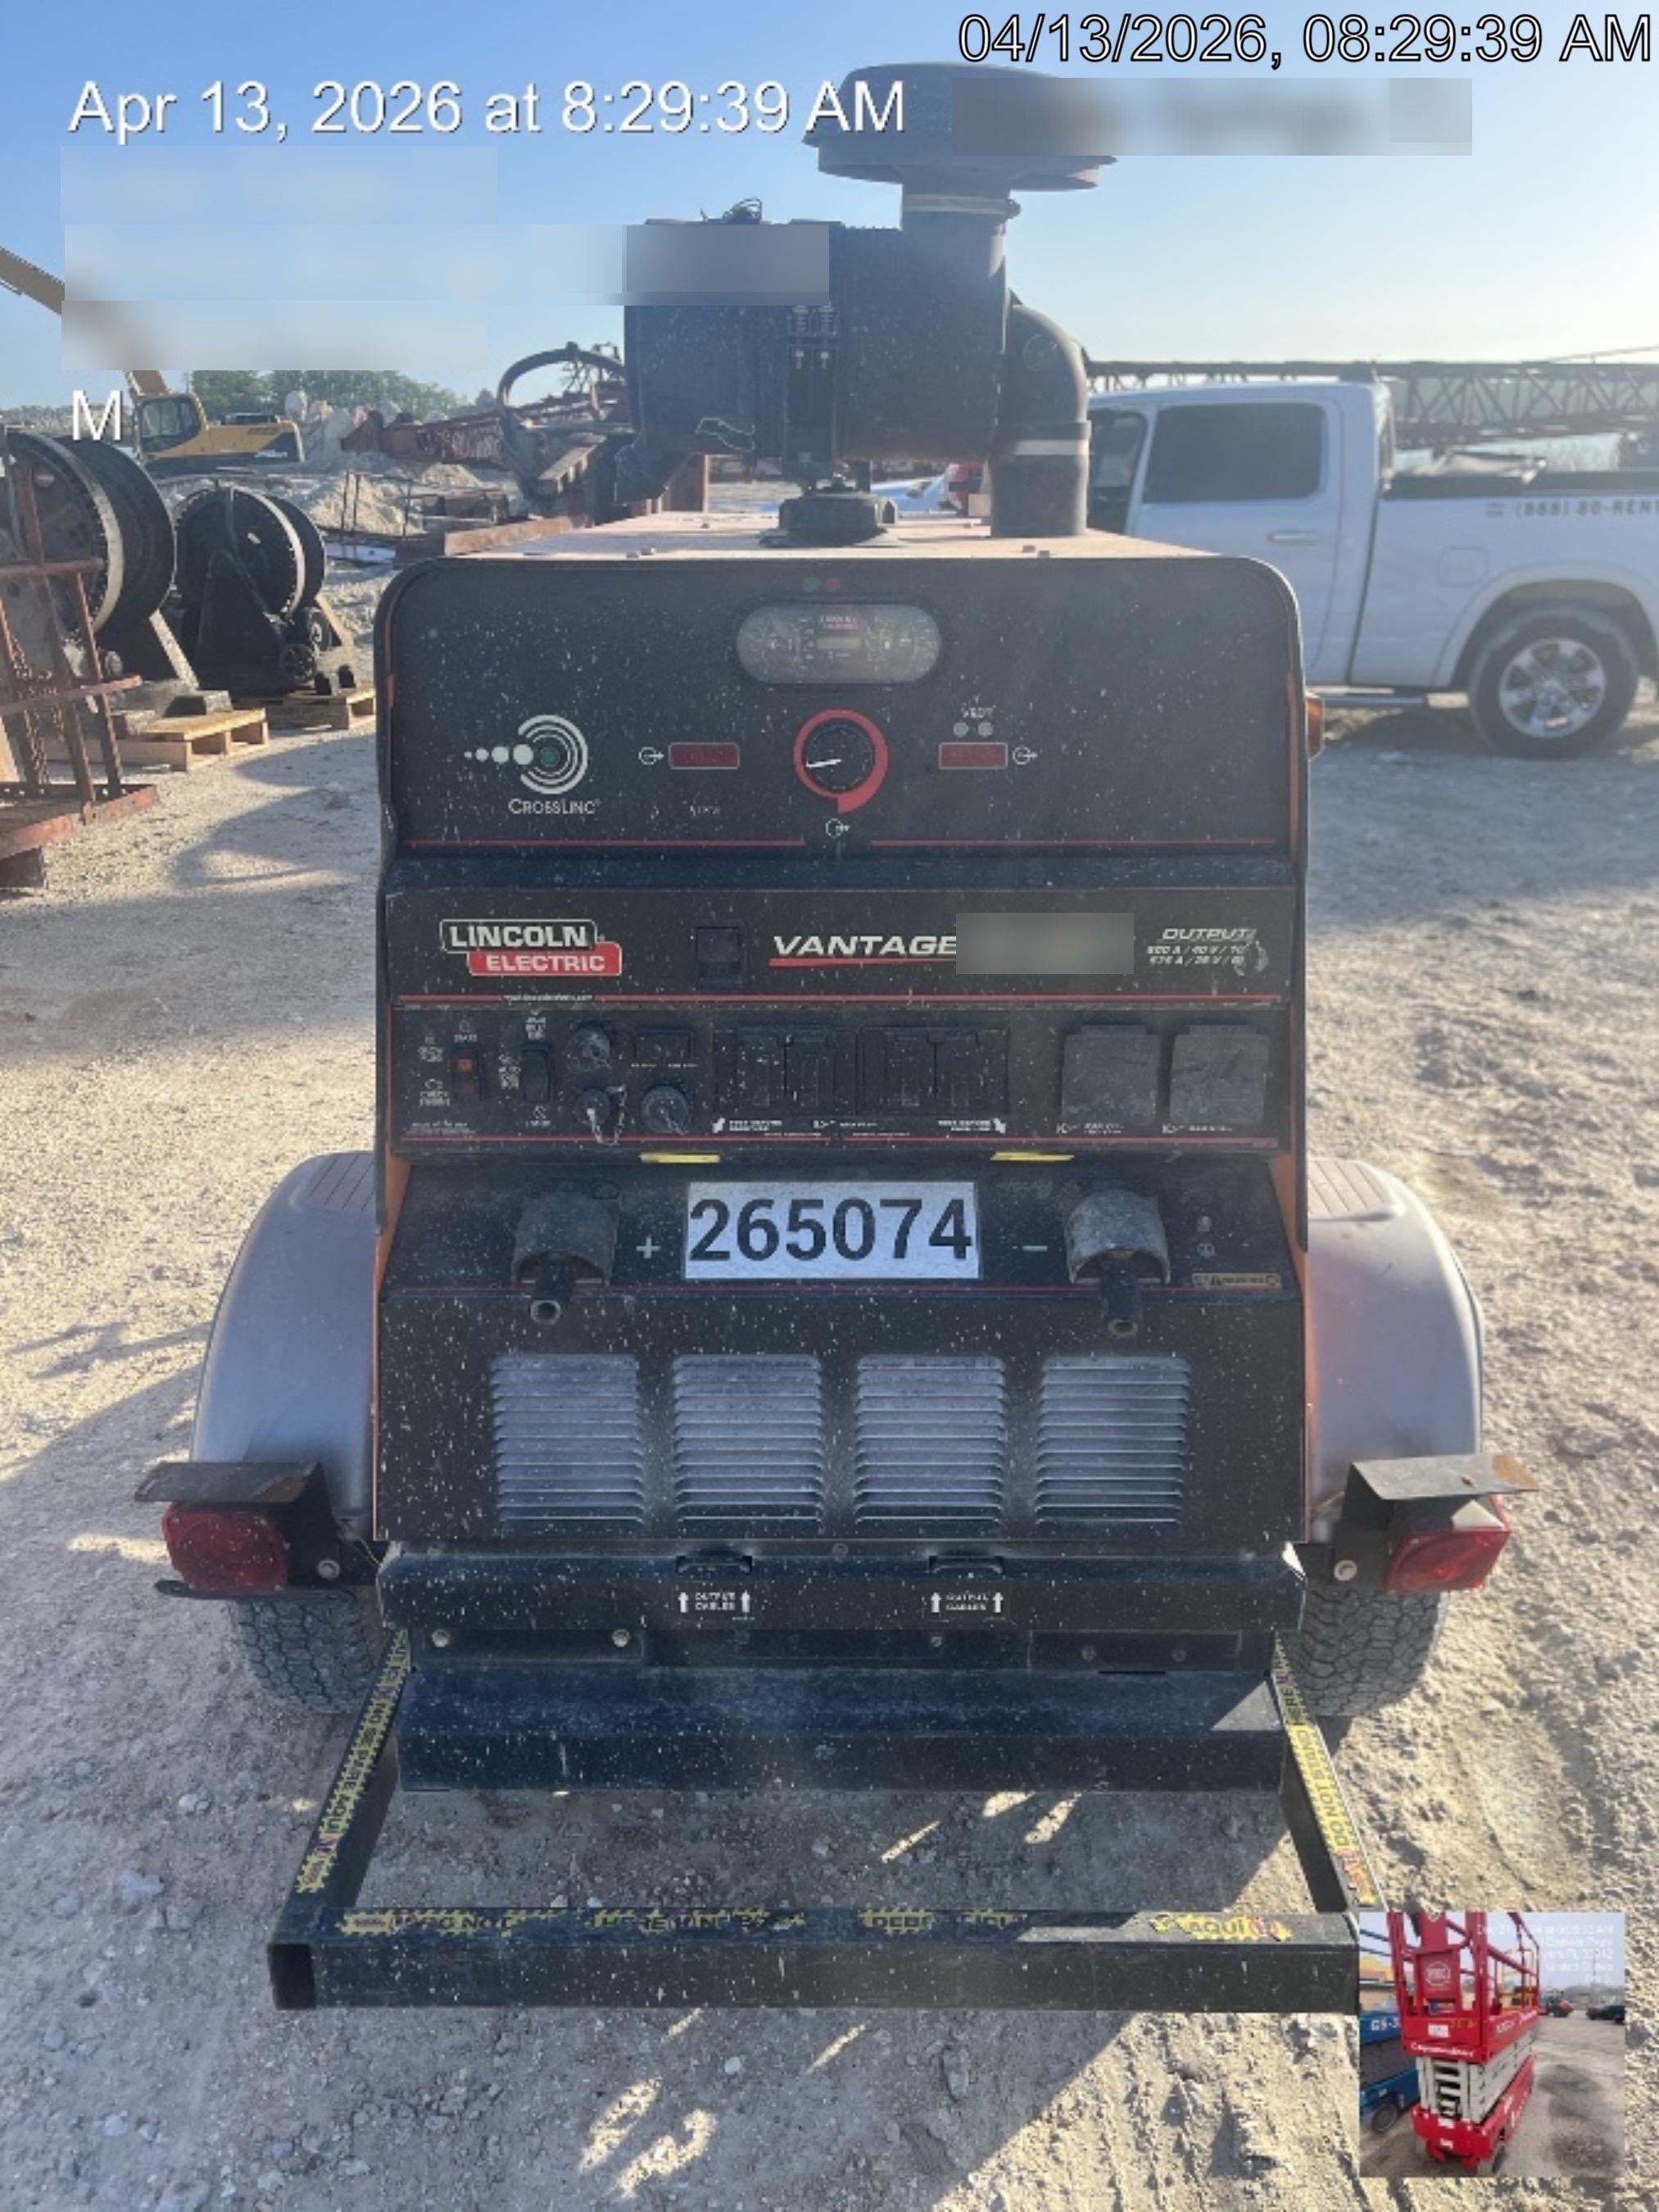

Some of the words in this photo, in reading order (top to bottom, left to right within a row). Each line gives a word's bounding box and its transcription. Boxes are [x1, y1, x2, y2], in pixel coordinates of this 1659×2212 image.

[448, 925, 587, 948] LINCOLN
[1162, 927, 1250, 941] OUTPUT
[773, 936, 957, 956] VANTAGE
[485, 955, 606, 972] ELECTRIC
[688, 1196, 972, 1262] 265074
[1317, 1784, 1339, 1819] NOT
[1331, 1819, 1350, 1847] DO
